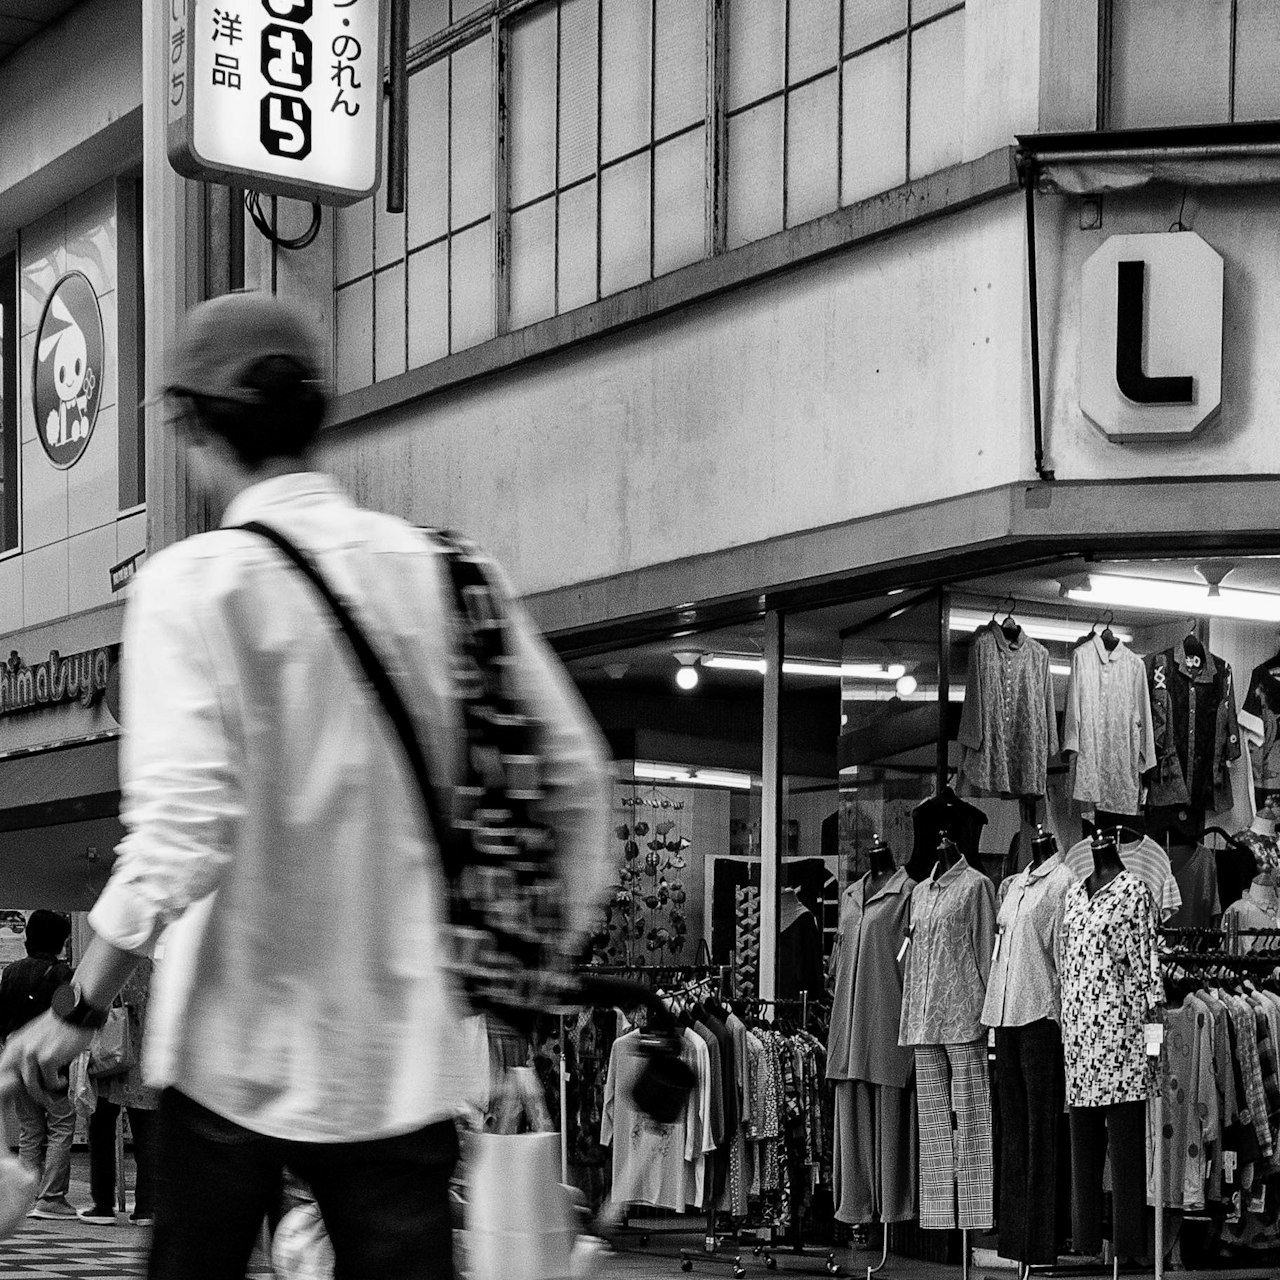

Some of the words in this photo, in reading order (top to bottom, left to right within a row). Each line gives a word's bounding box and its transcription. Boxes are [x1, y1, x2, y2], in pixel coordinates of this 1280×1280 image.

[211, 8, 243, 90] 洋品
[263, 0, 310, 157] むら
[330, 0, 362, 117] ・のれん
